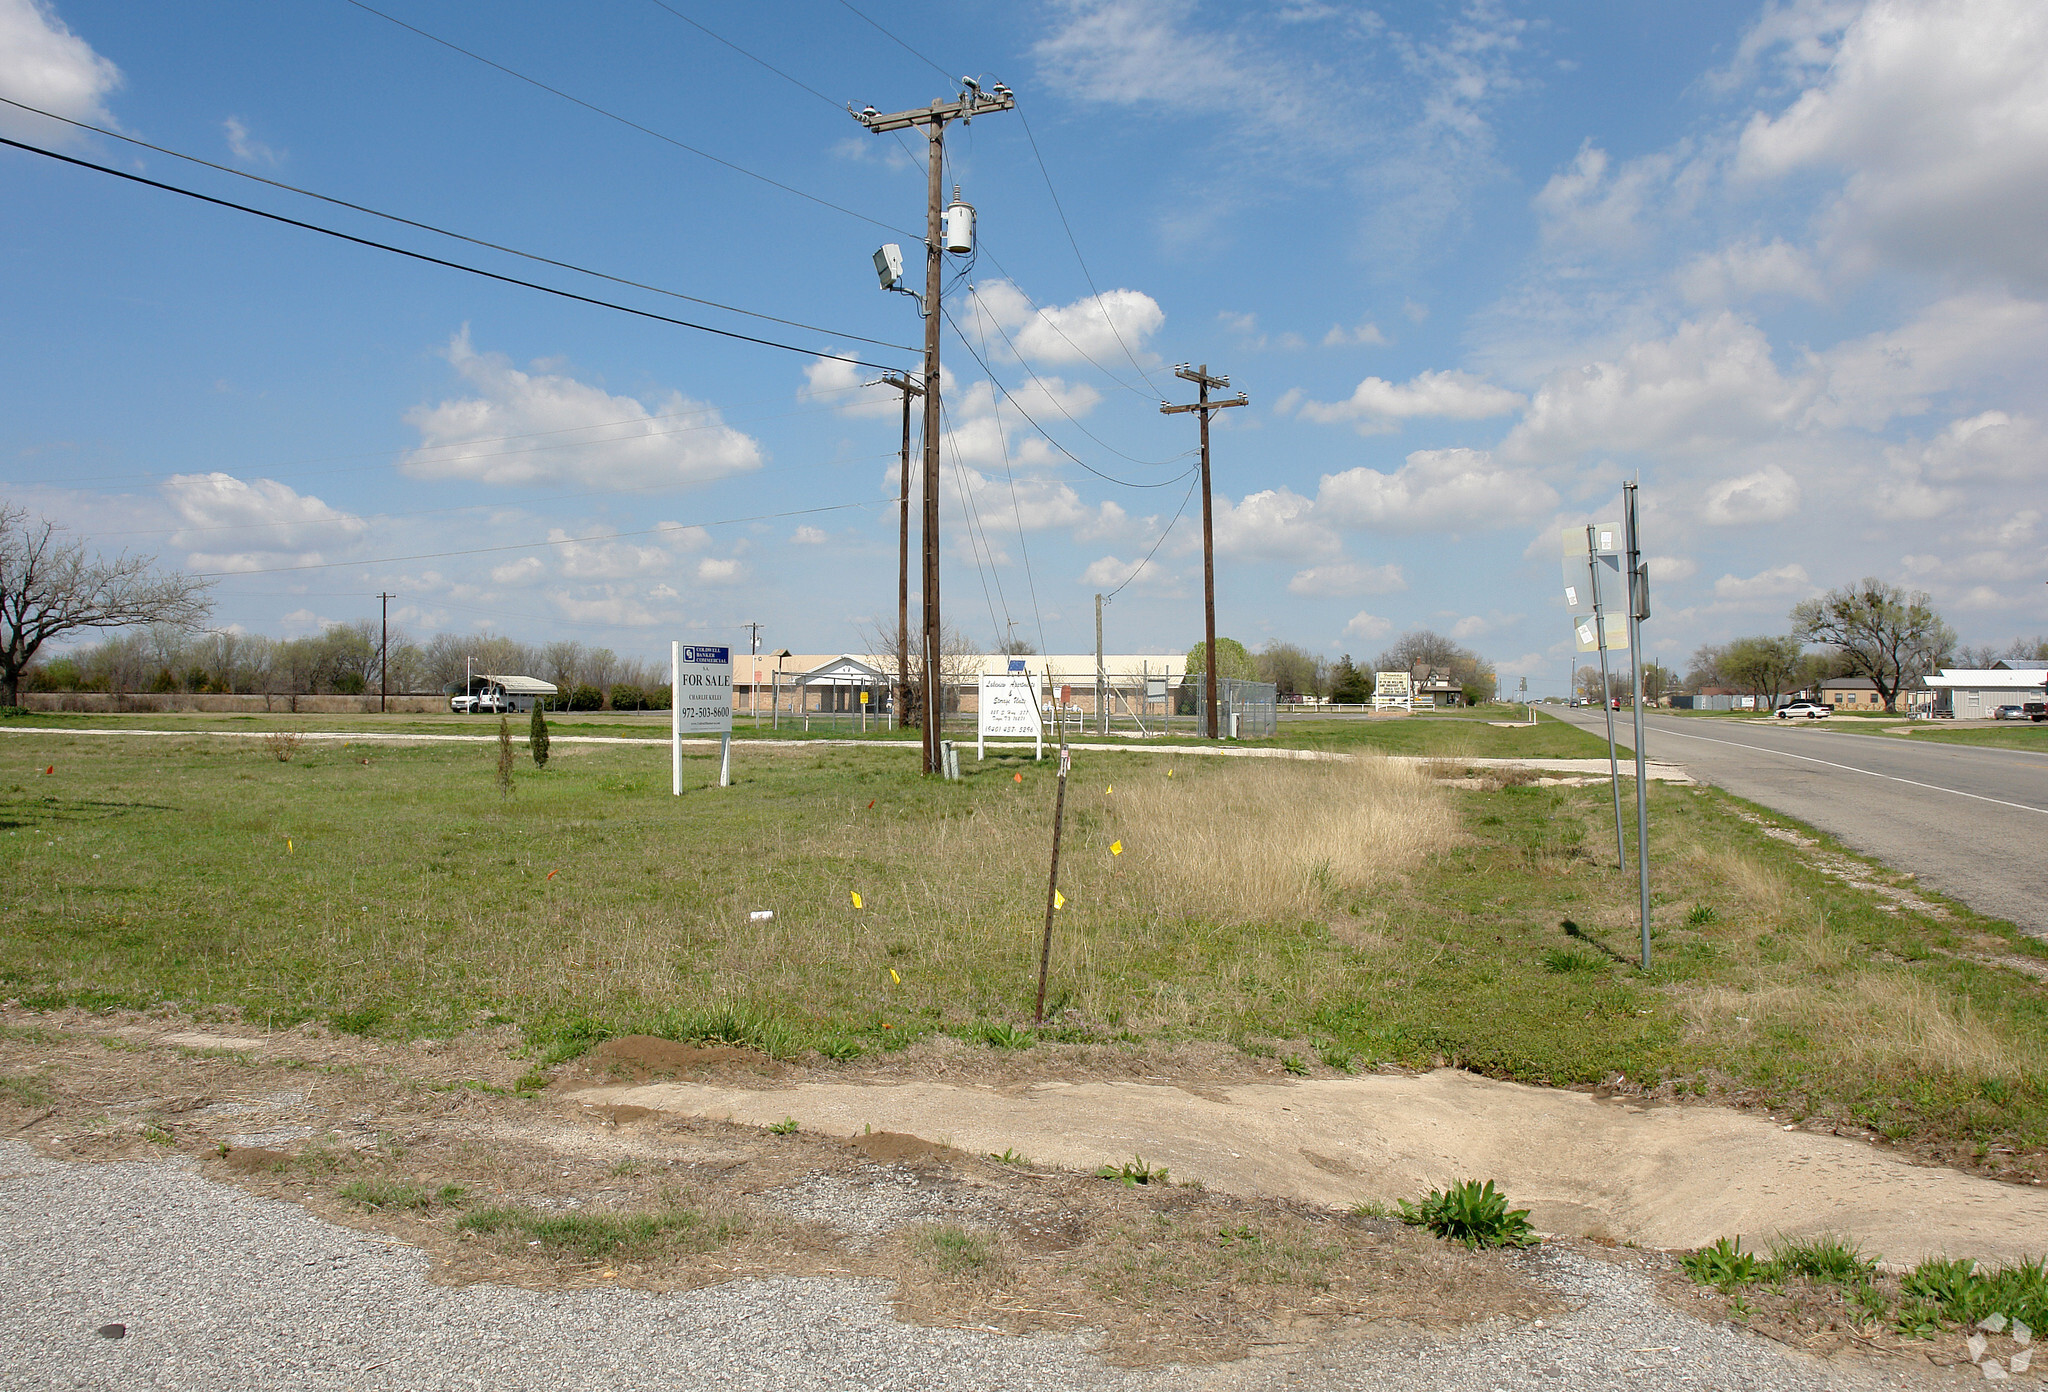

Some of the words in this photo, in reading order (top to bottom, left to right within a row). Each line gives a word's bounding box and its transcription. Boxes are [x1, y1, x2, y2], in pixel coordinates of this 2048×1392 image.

[683, 674, 702, 686] FOR
[705, 675, 730, 686] SALE
[682, 706, 730, 718] 972-503-8600
